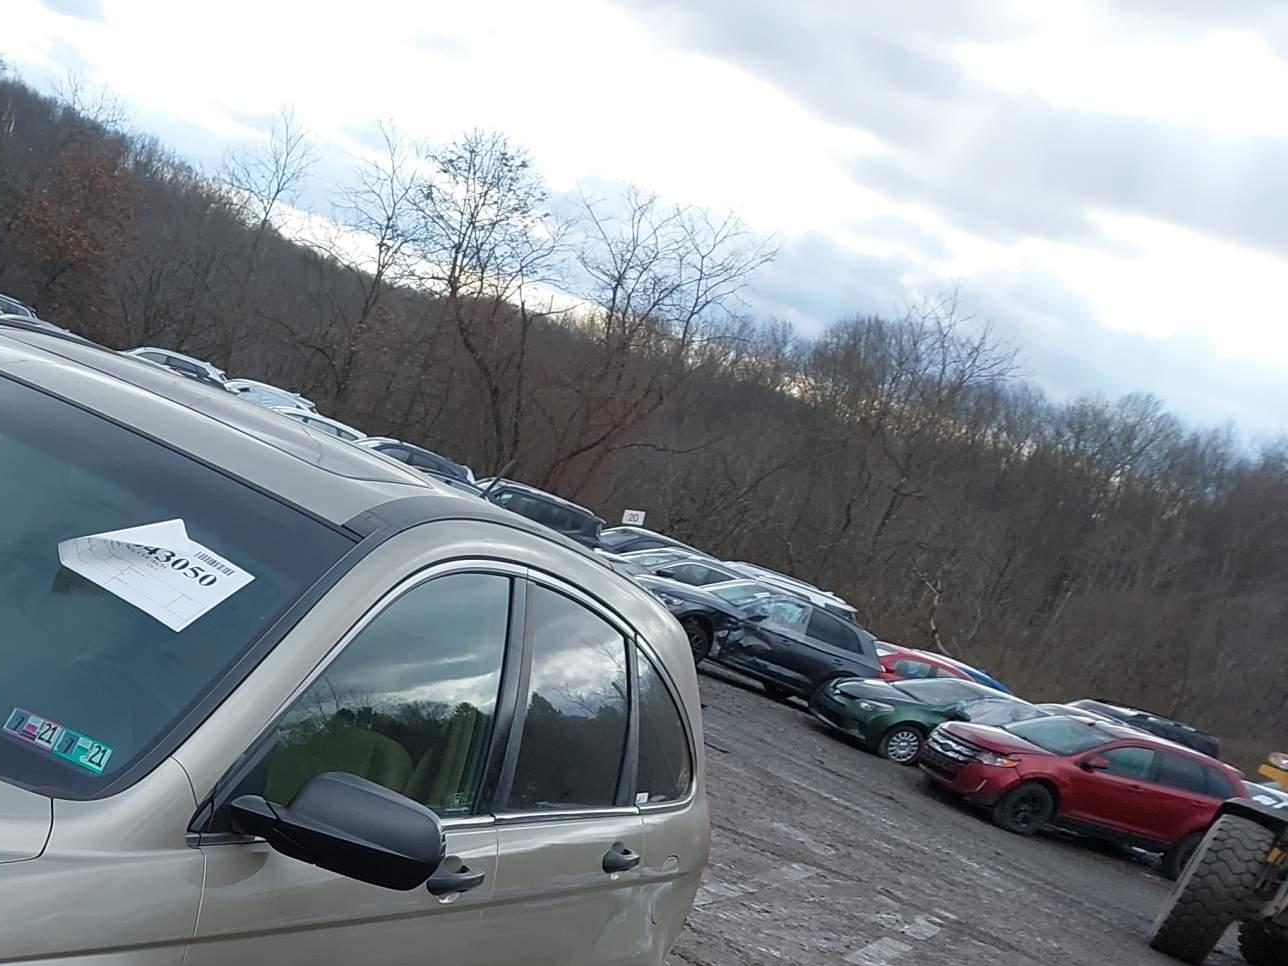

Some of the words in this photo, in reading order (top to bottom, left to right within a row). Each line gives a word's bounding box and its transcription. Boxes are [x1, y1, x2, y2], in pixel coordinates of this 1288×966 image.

[132, 543, 218, 587] 43050
[37, 722, 58, 744] 21
[88, 744, 108, 768] 21
